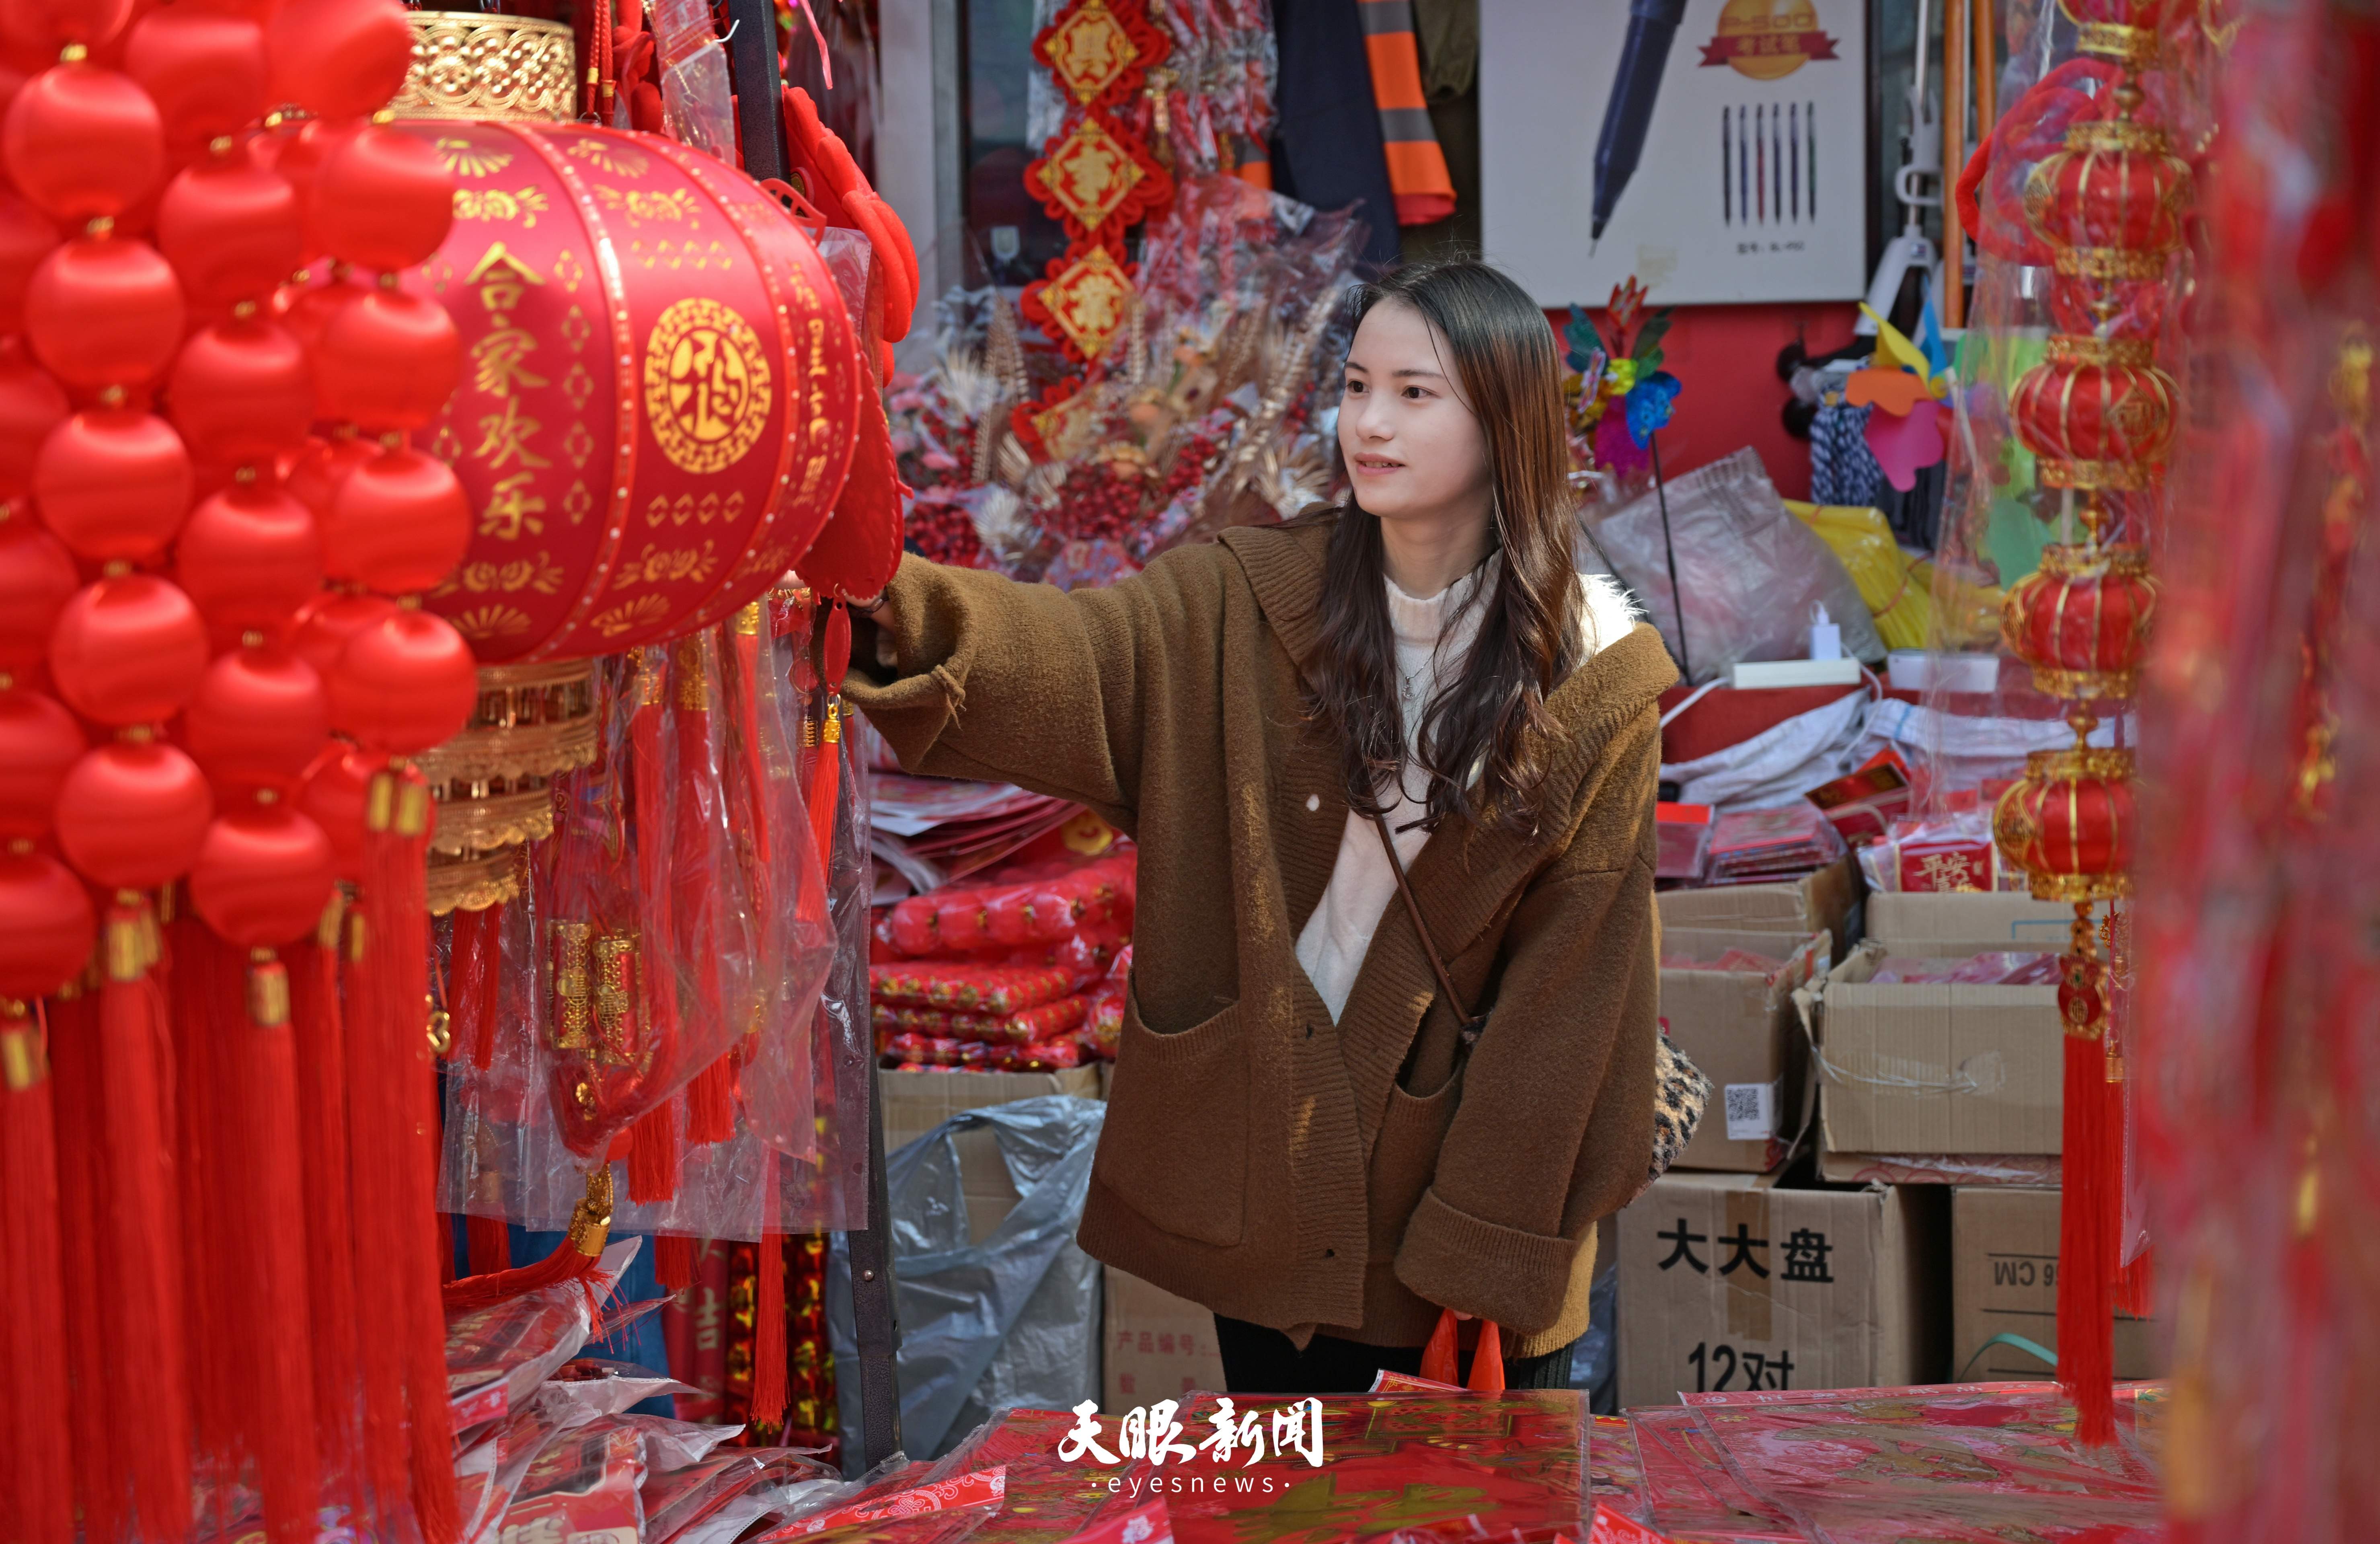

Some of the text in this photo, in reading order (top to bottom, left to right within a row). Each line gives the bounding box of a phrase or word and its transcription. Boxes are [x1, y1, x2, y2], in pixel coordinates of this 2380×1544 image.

[463, 241, 554, 541] 合家欢乐
[1657, 1218, 1834, 1283] 大大盘
[1994, 1261, 2035, 1286] CM
[1688, 1342, 1794, 1392] 12对
